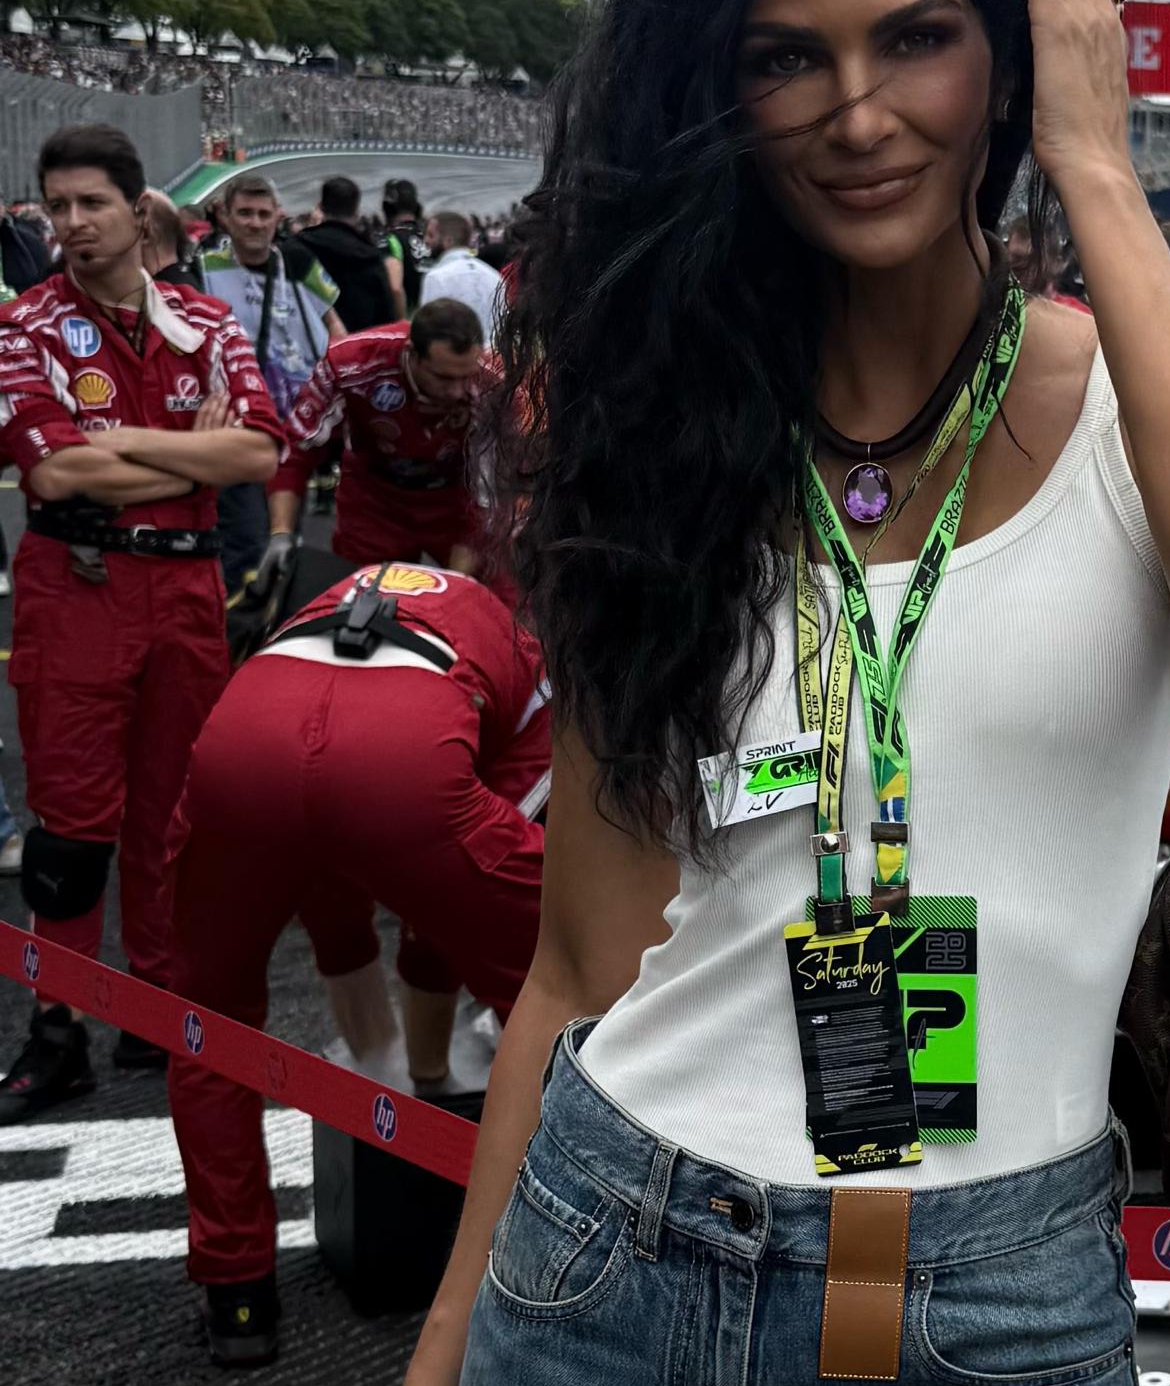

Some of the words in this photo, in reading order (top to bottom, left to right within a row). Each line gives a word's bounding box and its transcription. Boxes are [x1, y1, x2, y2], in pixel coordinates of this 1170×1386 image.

[65, 319, 96, 357] hp
[847, 586, 868, 622] VIP
[902, 588, 924, 626] VIP
[828, 666, 842, 735] PADDOCK
[835, 696, 845, 736] CLUB
[745, 740, 796, 761] SPRINT
[769, 752, 820, 780] GRI
[25, 942, 39, 980] hp
[796, 941, 890, 995] Saturday
[836, 978, 858, 990] 2025
[186, 1010, 203, 1054] hp
[375, 1093, 395, 1142] hp
[838, 1147, 898, 1162] PADDOCK
